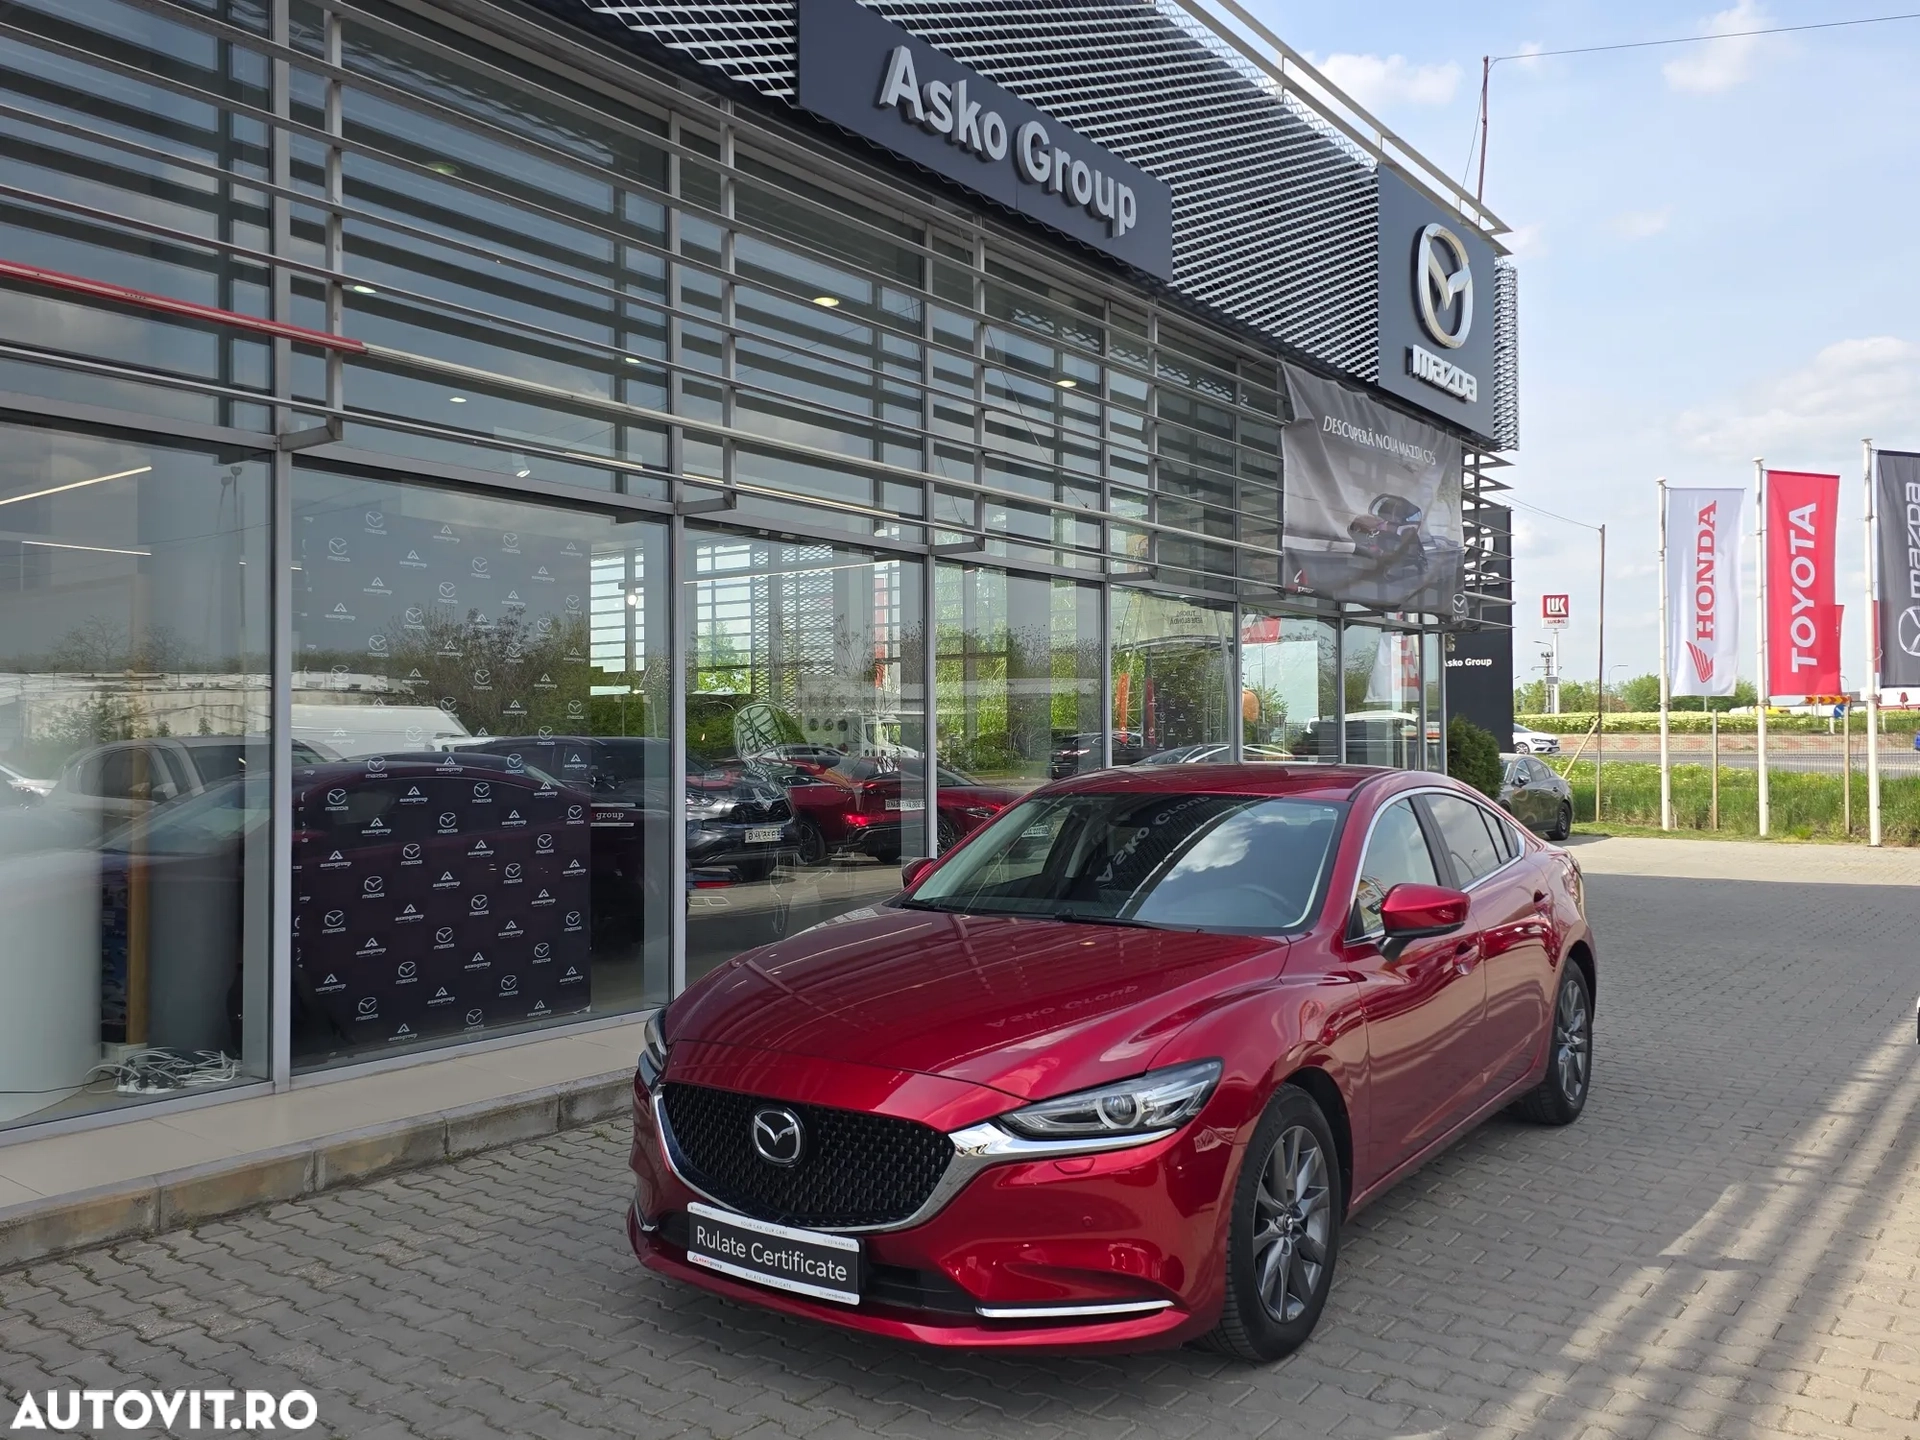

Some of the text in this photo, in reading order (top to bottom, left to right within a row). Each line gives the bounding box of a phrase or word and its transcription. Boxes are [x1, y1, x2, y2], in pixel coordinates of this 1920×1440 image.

[879, 45, 1136, 239] Asko Group
[1412, 344, 1477, 402] mazda
[1323, 416, 1375, 447] DESCOPERĂ
[1695, 500, 1717, 641] HONDA
[1788, 502, 1818, 673] TOYOTA
[1465, 657, 1492, 667] Group
[696, 1225, 847, 1282] Rulate Certificate
